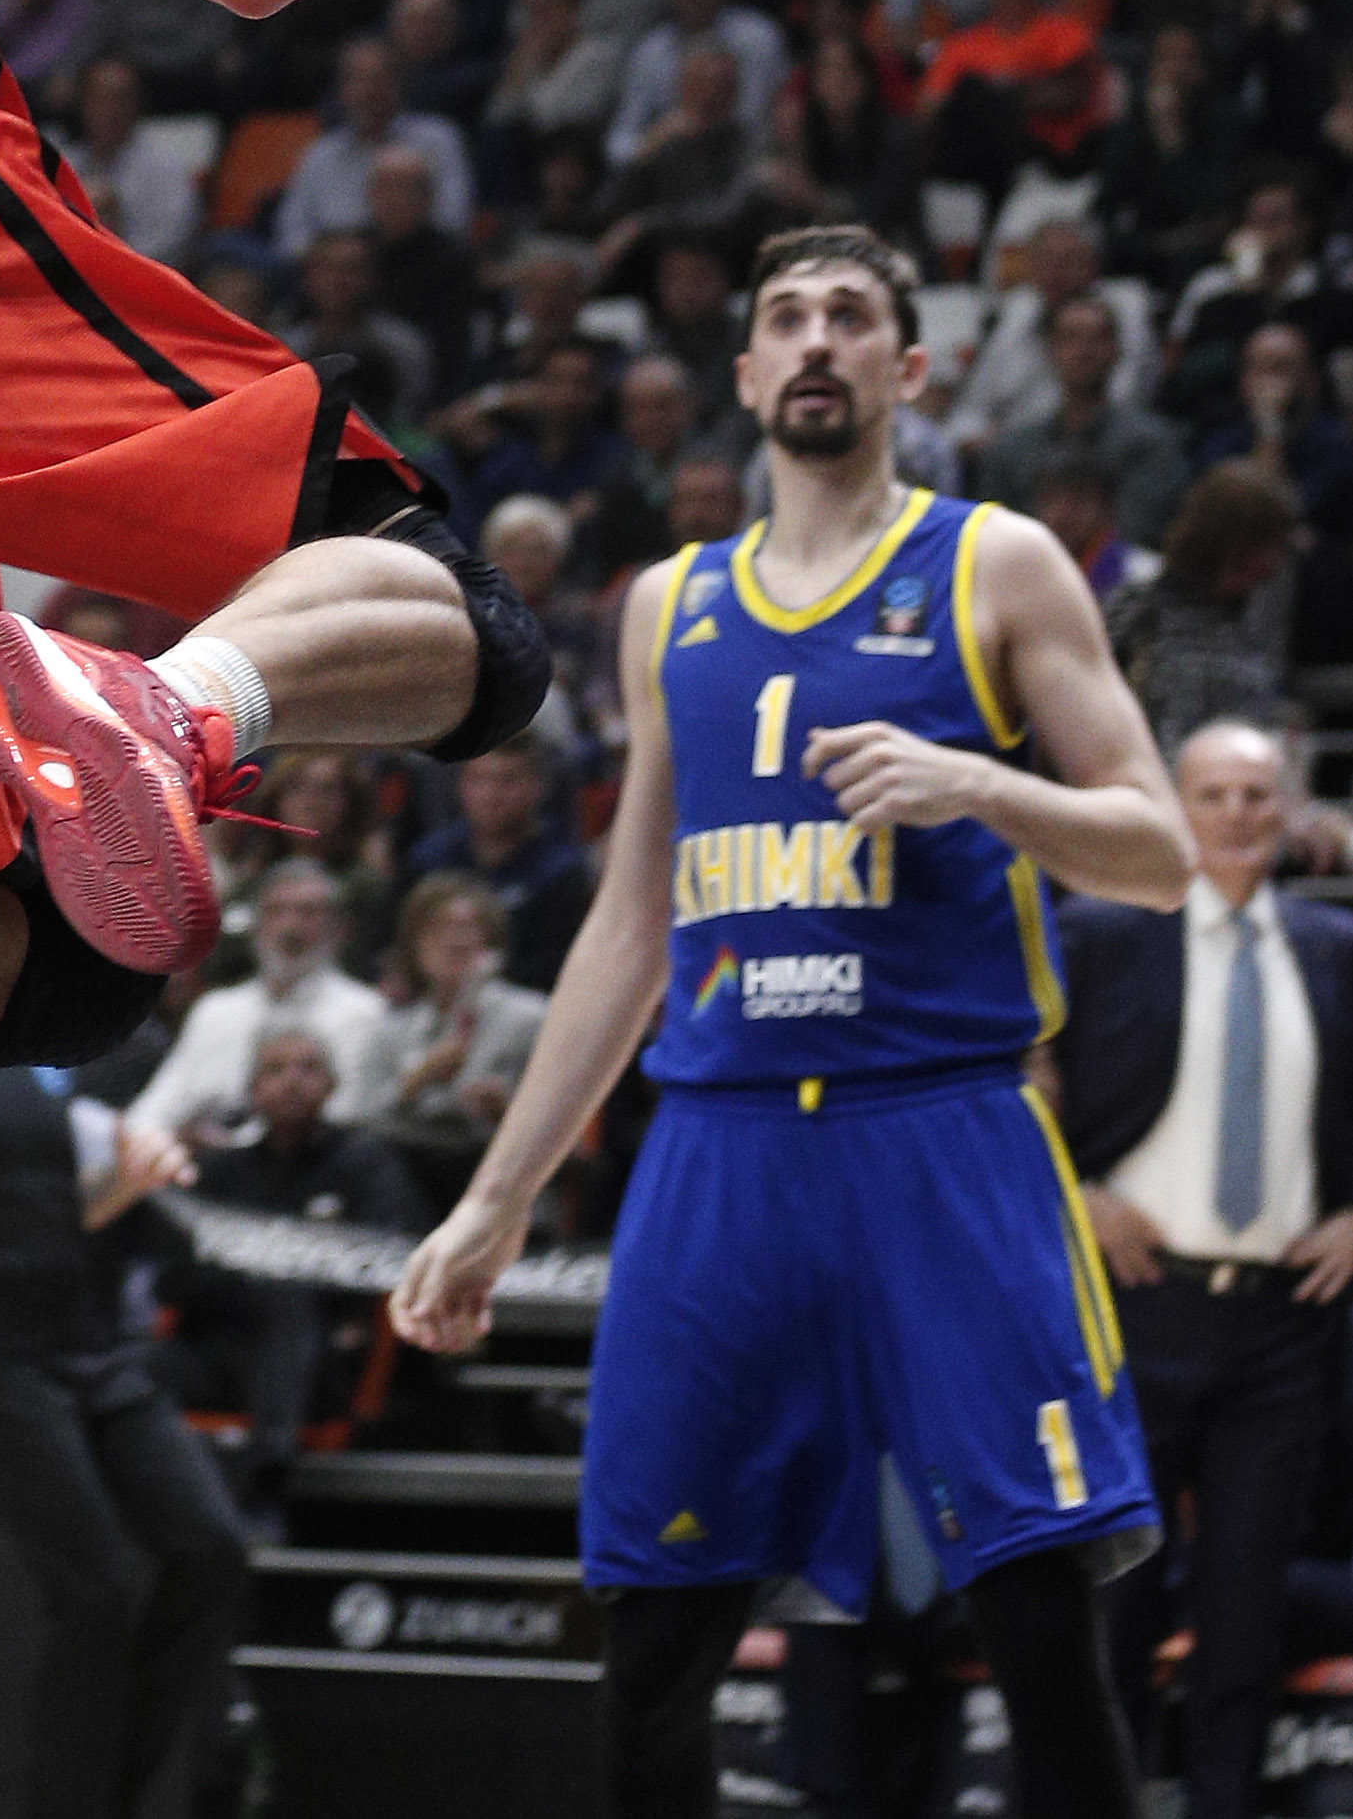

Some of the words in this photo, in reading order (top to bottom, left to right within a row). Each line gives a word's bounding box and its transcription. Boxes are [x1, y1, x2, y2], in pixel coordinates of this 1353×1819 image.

[752, 673, 797, 778] 1
[742, 953, 863, 998] HIMKI
[1035, 1398, 1089, 1512] 1
